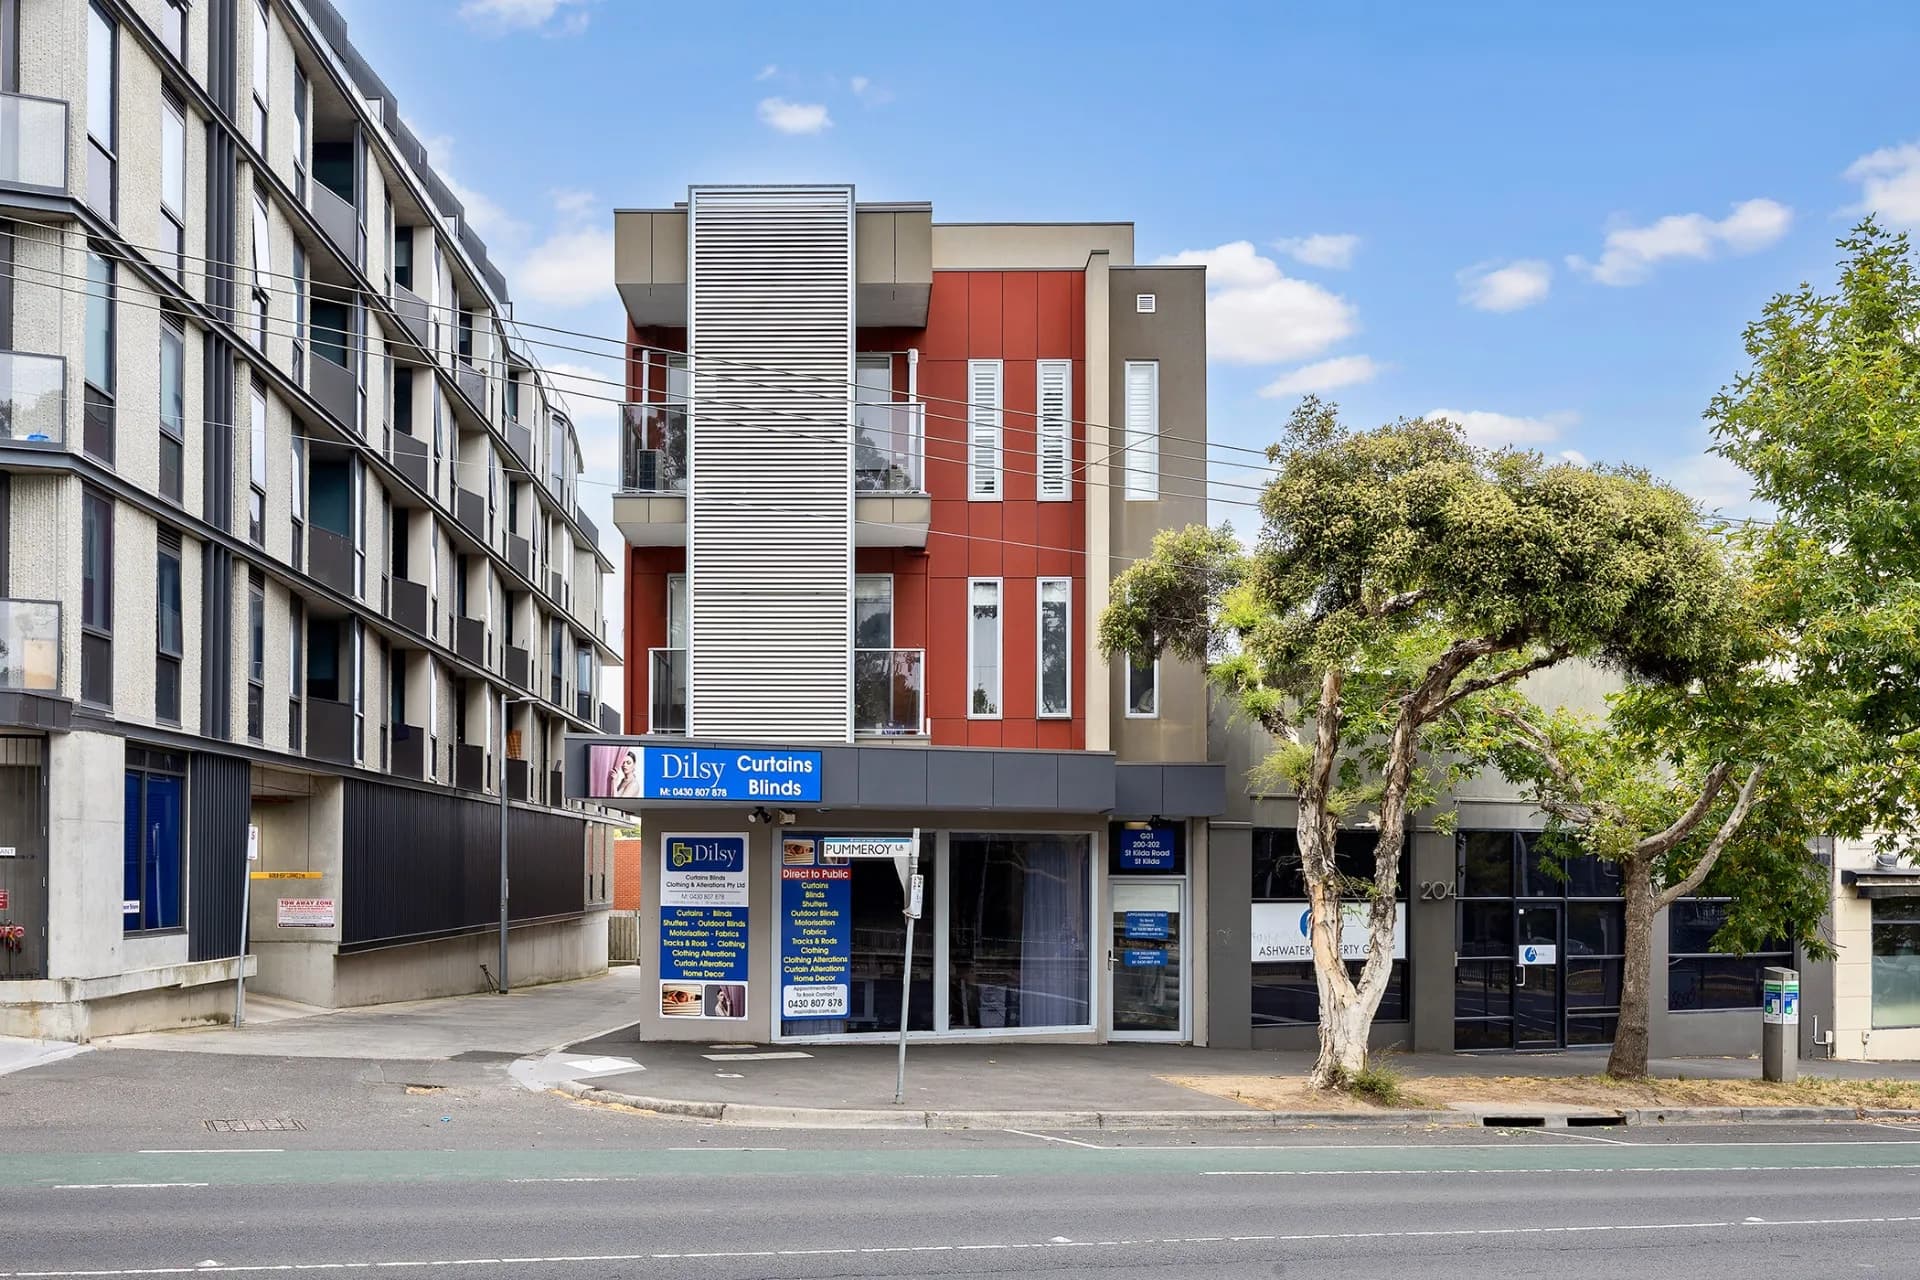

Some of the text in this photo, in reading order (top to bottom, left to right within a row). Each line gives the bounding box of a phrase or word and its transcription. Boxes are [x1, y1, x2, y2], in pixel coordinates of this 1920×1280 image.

[661, 752, 813, 788] Dilsy Curtains
[660, 788, 727, 797] M: 0430 807 878
[749, 780, 801, 796] Blinds
[825, 844, 891, 855] PUMMEROY
[1124, 849, 1170, 857] St Kilda Road
[695, 843, 736, 867] Dilsy
[782, 869, 849, 879] Direct to Public
[666, 881, 690, 889] Clothing
[801, 881, 829, 889] Curtains
[805, 891, 825, 899] Blinds
[1421, 881, 1457, 900] 204
[802, 900, 828, 908] Shutters
[676, 909, 703, 917] Curtains
[790, 909, 839, 917] Outdoor Blinds
[717, 940, 745, 949] Clothing
[672, 949, 736, 958] Clothing Alterations
[800, 946, 829, 955] Clothing
[1258, 945, 1311, 956] ASHWATER
[673, 959, 734, 968] Curtain Alterations
[783, 955, 848, 965] Clothing Alterations
[784, 965, 808, 973] Curtain
[704, 970, 725, 978] Decor
[788, 998, 843, 1008] 0430 807 878
